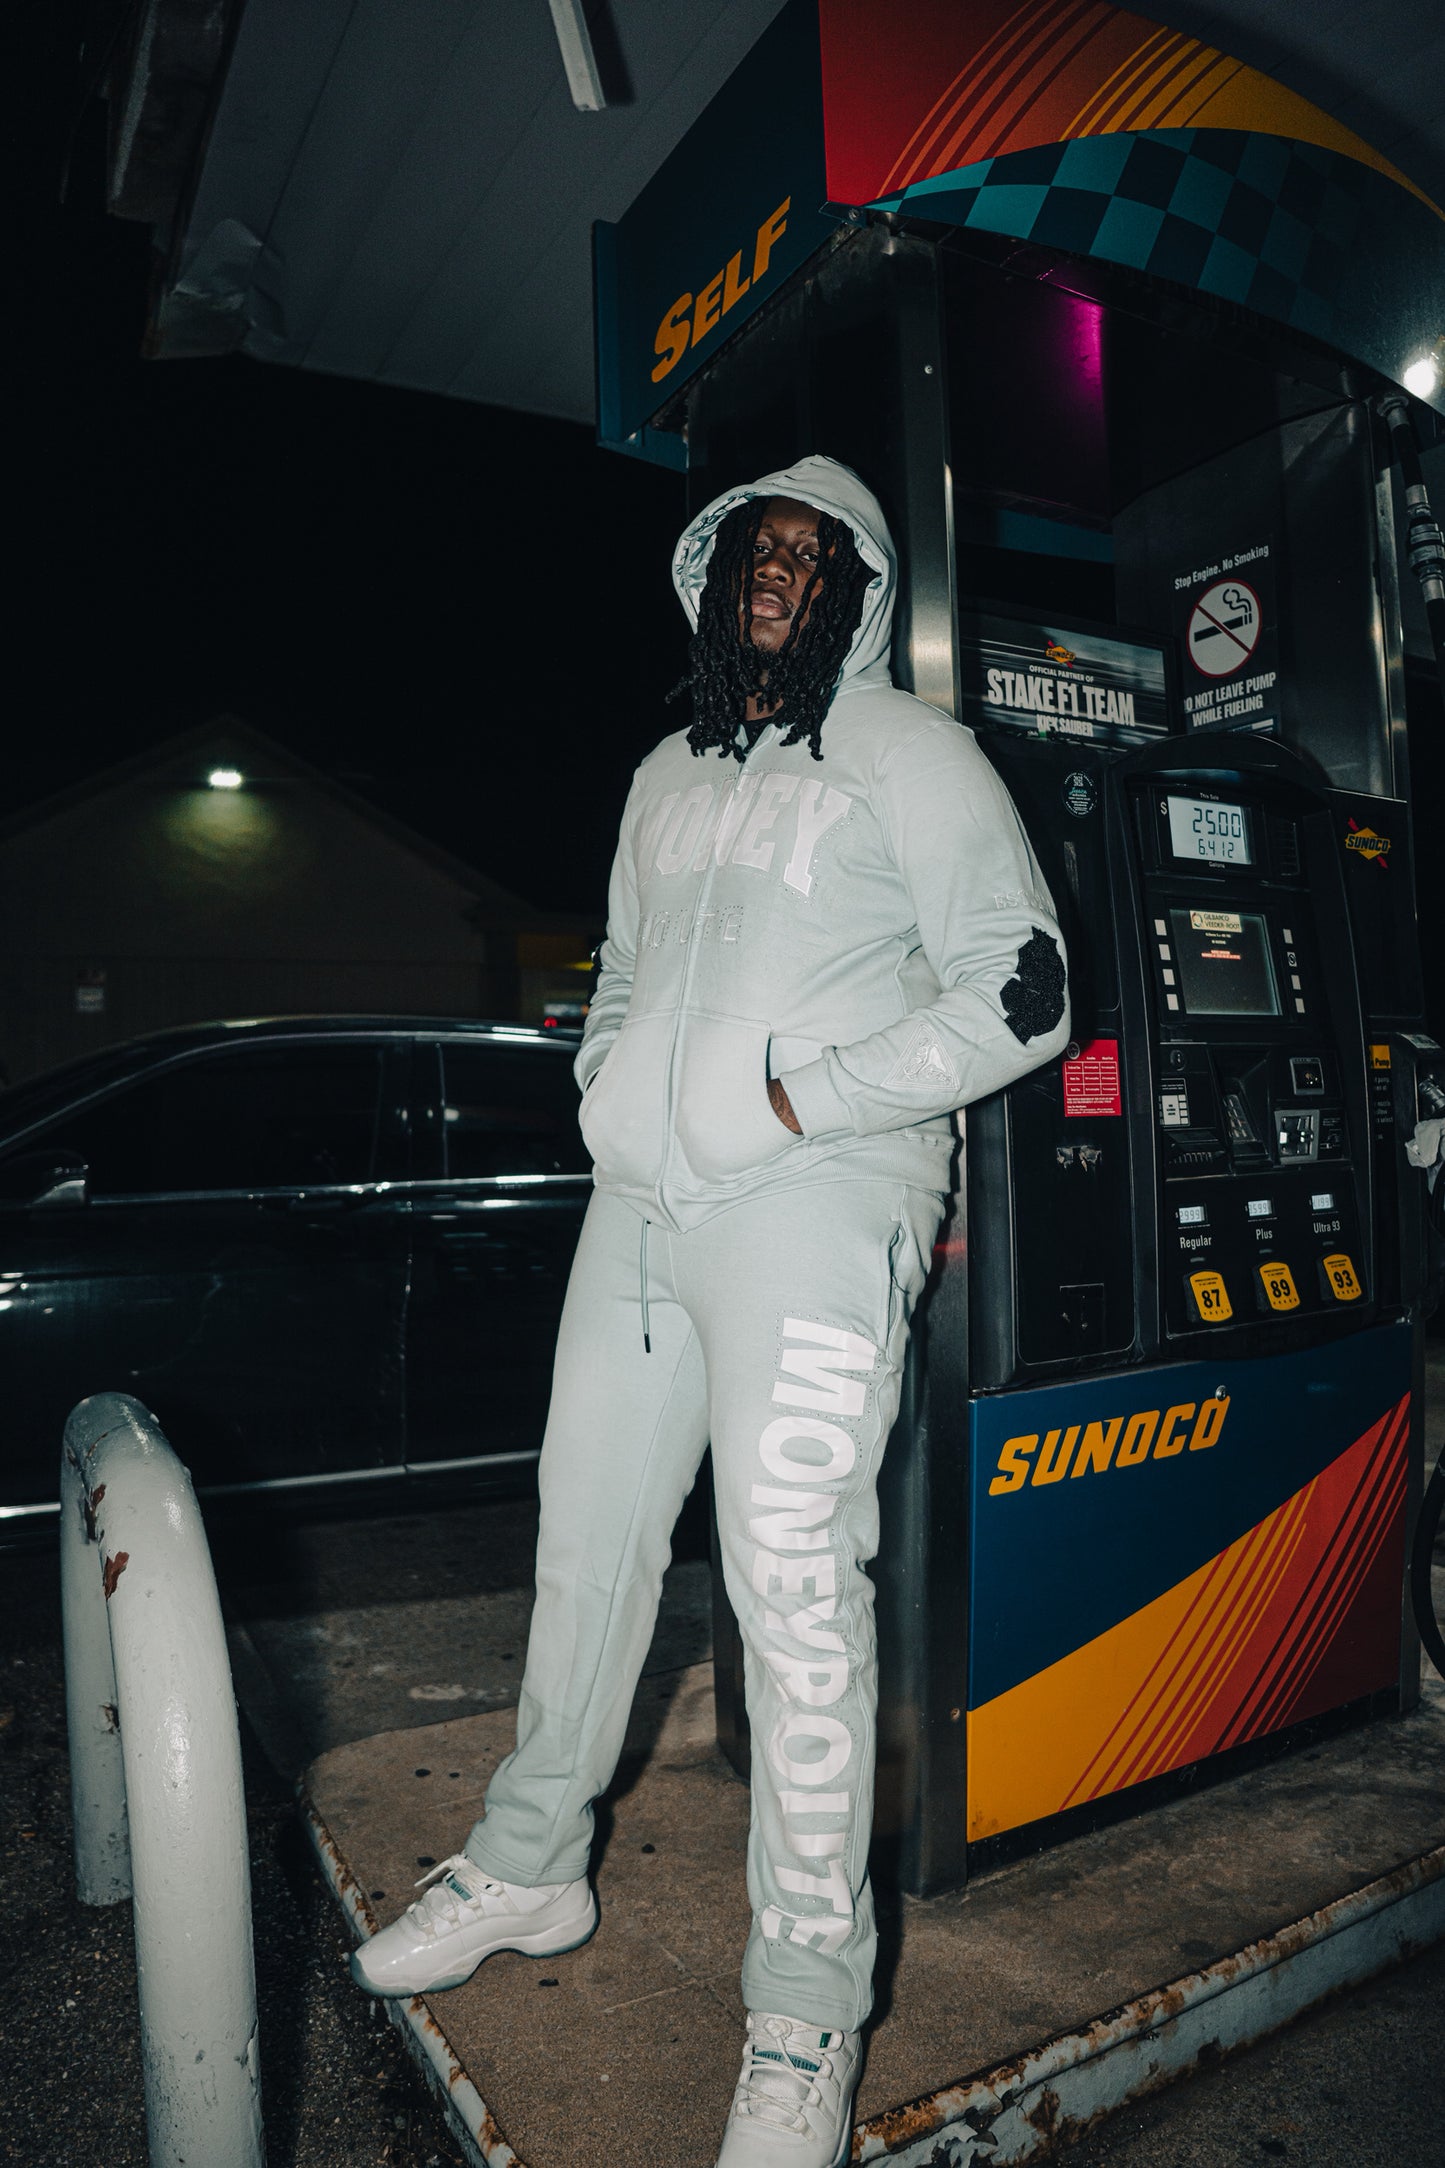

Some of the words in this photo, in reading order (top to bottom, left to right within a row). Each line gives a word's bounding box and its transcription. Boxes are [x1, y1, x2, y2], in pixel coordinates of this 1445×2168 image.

[651, 195, 791, 383] SELF
[1174, 576, 1191, 590] Stop
[1192, 564, 1221, 582] Engine.
[1222, 558, 1233, 571] No
[1234, 545, 1269, 566] Smoking
[1029, 665, 1057, 676] OFFICIAL
[1058, 670, 1085, 681] PARTNER
[1085, 675, 1094, 683] OF
[987, 668, 1055, 714] STAKE
[1057, 680, 1079, 717] F1
[1083, 686, 1136, 727] TEAM
[1195, 690, 1214, 709] NOT
[1216, 680, 1245, 703] LEAVE
[1246, 671, 1277, 694] PUMP
[1192, 705, 1222, 727] WHILE
[1223, 694, 1264, 718] FUELING
[1059, 717, 1093, 737] SAUBER
[1160, 801, 1168, 815] $
[1347, 835, 1389, 852] SUNOCO
[1256, 1229, 1273, 1240] Plus
[1313, 1221, 1331, 1233] Ultra
[1332, 1220, 1340, 1231] 93
[1180, 1235, 1212, 1250] Regular
[1270, 1279, 1290, 1298] 89
[1334, 1270, 1353, 1288] 93
[1201, 1289, 1221, 1308] 87
[988, 1396, 1231, 1496] SUNOCO
